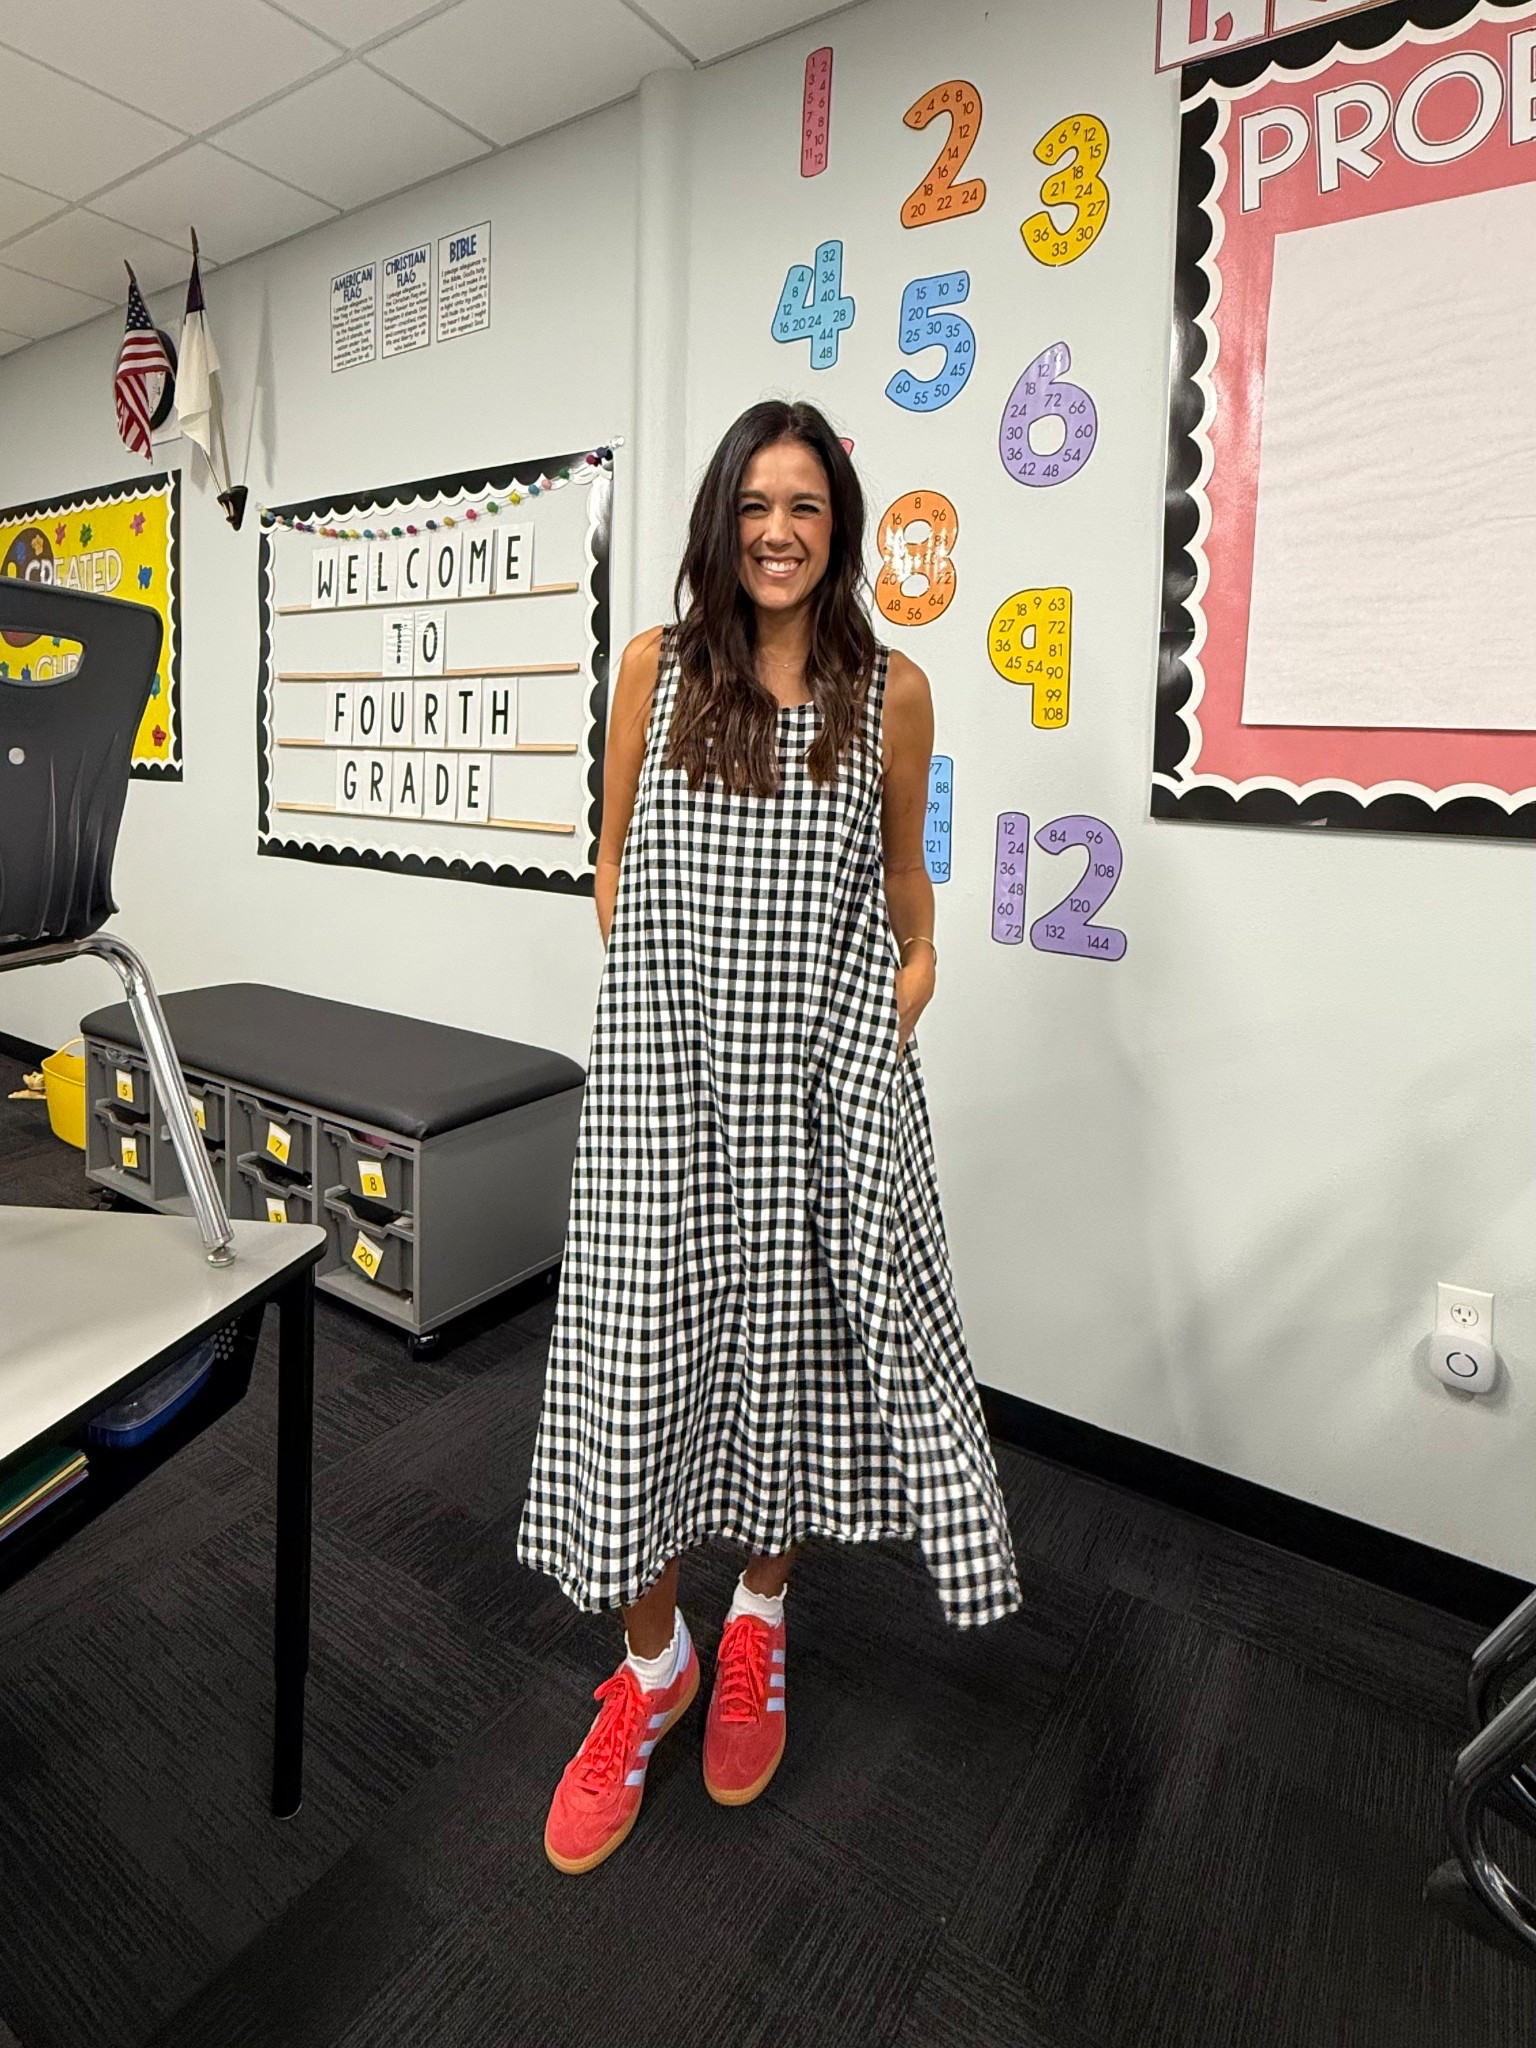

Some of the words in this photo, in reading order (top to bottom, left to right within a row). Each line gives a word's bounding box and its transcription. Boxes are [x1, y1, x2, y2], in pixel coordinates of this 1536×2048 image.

[821, 62, 827, 72] 2
[808, 75, 814, 86] 3
[807, 93, 813, 104] 5
[818, 97, 825, 108] 6
[914, 111, 922, 124] 2
[927, 99, 935, 111] 4
[941, 90, 949, 102] 6
[955, 90, 963, 102] 8
[963, 102, 974, 116] 10
[807, 112, 812, 122] 7
[818, 117, 824, 127] 8
[806, 130, 812, 140] 9
[815, 134, 824, 146] 10
[959, 124, 970, 139] 12
[1046, 143, 1054, 158] 3
[1059, 130, 1067, 144] 6
[1072, 121, 1080, 135] 9
[1084, 127, 1096, 142] 12
[805, 148, 813, 159] 11
[815, 154, 824, 165] 12
[948, 146, 959, 160] 14
[1090, 143, 1102, 159] 15
[938, 165, 949, 179] 16
[1072, 165, 1084, 180] 18
[924, 184, 933, 197] 18
[1051, 181, 1065, 197] 21
[1075, 182, 1092, 199] 24
[911, 203, 926, 218] 20
[937, 196, 952, 211] 22
[962, 188, 977, 204] 24
[1087, 200, 1105, 217] 27
[450, 234, 477, 264] BIBLE
[1033, 228, 1050, 243] 36
[1052, 241, 1068, 257] 33
[1076, 226, 1093, 242] 30
[385, 249, 426, 277] CHRISTIAN
[822, 249, 835, 263] 32
[333, 267, 373, 294] AMERICAN
[397, 269, 416, 288] FLAG
[798, 271, 804, 282] 4
[822, 270, 835, 283] 36
[343, 286, 362, 303] FLAG
[792, 286, 798, 298] 8
[820, 289, 835, 302] 40
[915, 286, 926, 300] 15
[938, 282, 949, 297] 10
[957, 279, 965, 292] 5
[783, 304, 792, 316] 12
[909, 307, 923, 321] 20
[780, 322, 789, 334] 16
[792, 318, 806, 331] 20
[808, 314, 822, 328] 24
[833, 309, 846, 323] 28
[820, 328, 833, 340] 44
[905, 329, 920, 343] 25
[926, 321, 941, 335] 30
[945, 324, 960, 338] 35
[819, 347, 832, 359] 48
[954, 340, 970, 353] 40
[950, 362, 966, 376] 45
[1038, 364, 1049, 377] 12
[896, 380, 910, 394] 60
[913, 391, 928, 405] 55
[934, 384, 950, 398] 50
[1025, 382, 1036, 396] 18
[1045, 393, 1062, 408] 72
[1069, 400, 1086, 415] 66
[1010, 404, 1027, 418] 24
[1007, 426, 1023, 440] 30
[1075, 424, 1093, 439] 60
[1007, 447, 1023, 461] 36
[1062, 448, 1081, 463] 54
[1018, 462, 1036, 476] 42
[1041, 463, 1059, 478] 48
[914, 497, 921, 509] 8
[892, 513, 902, 526] 16
[931, 509, 947, 523] 96
[318, 535, 520, 599] WELCOME
[886, 599, 901, 612] 48
[928, 593, 944, 607] 64
[1016, 603, 1027, 617] 18
[1033, 596, 1042, 610] 9
[1048, 597, 1065, 612] 63
[907, 607, 922, 621] 56
[999, 618, 1015, 633] 27
[1048, 620, 1065, 635] 72
[392, 621, 438, 664] TO
[995, 639, 1011, 653] 36
[1049, 643, 1063, 658] 81
[1005, 655, 1022, 670] 45
[1026, 660, 1043, 674] 54
[1046, 666, 1063, 680] 90
[1046, 688, 1062, 703] 99
[334, 690, 508, 735] FOURTH
[1043, 707, 1063, 721] 108
[343, 761, 480, 809] GRADE
[935, 782, 949, 794] 88
[933, 821, 950, 833] 110
[1003, 821, 1015, 835] 12
[1049, 829, 1066, 843] 84
[1085, 830, 1103, 845] 96
[925, 840, 941, 853] 121
[1008, 841, 1024, 855] 24
[930, 861, 949, 875] 132
[1000, 862, 1016, 876] 36
[1094, 863, 1115, 878] 108
[1008, 882, 1024, 896] 48
[997, 902, 1014, 916] 60
[1070, 898, 1090, 913] 120
[1005, 924, 1022, 939] 72
[1045, 924, 1065, 940] 132
[1086, 935, 1110, 951] 144
[275, 1140, 282, 1152] 7
[370, 1177, 377, 1191] 8
[358, 1246, 373, 1267] 20
